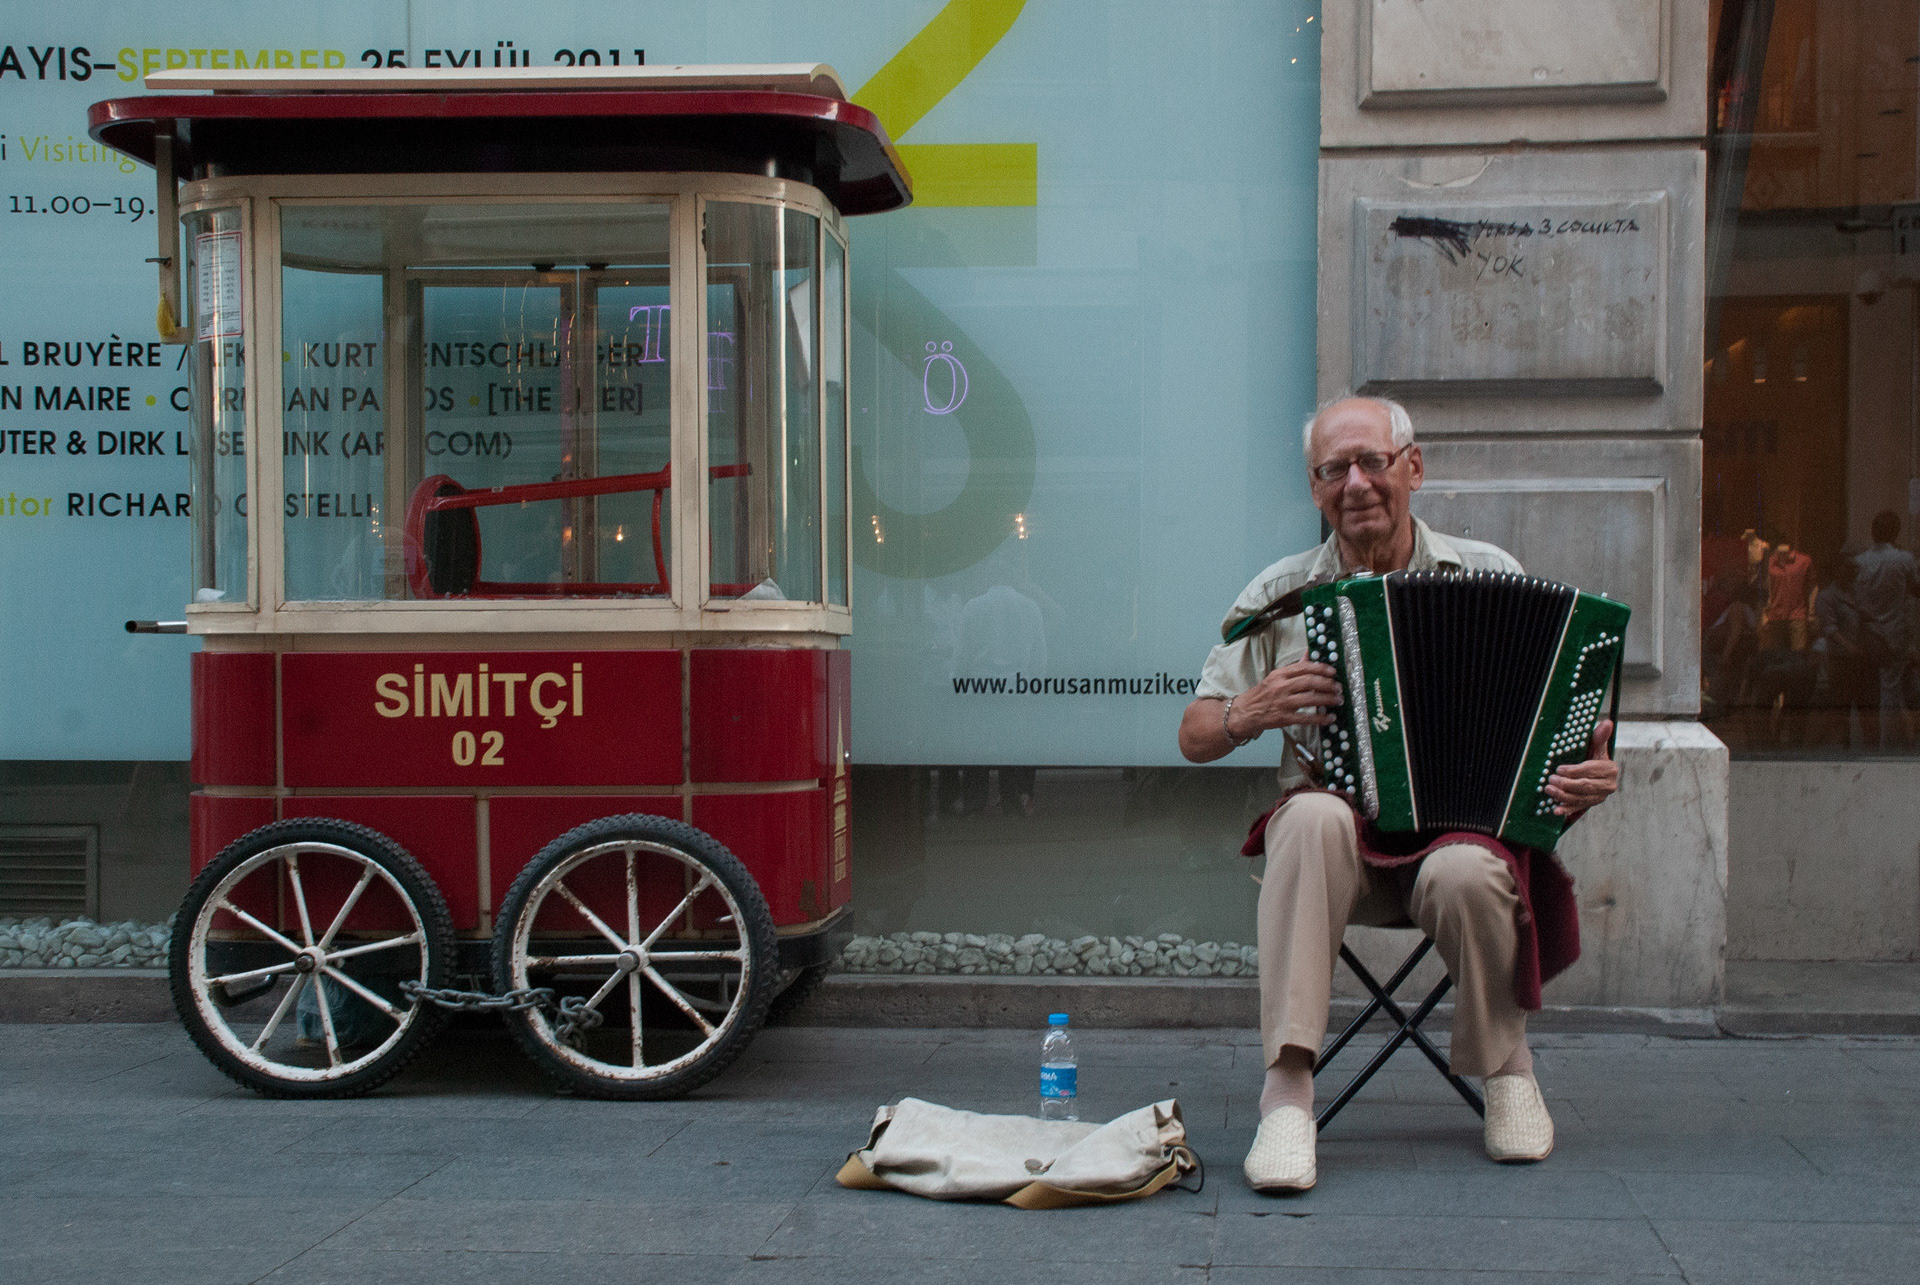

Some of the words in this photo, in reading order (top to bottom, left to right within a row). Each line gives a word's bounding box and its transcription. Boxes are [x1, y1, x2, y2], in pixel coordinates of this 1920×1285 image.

[1475, 251, 1524, 282] YOK
[23, 333, 162, 367] BRUYÈRE
[304, 342, 377, 368] KURT
[35, 386, 131, 411] MAIRE
[66, 430, 87, 456] &
[98, 431, 166, 456] DIRK
[0, 492, 53, 516] tor
[374, 662, 583, 729] SİMİTÇİ
[451, 730, 505, 766] 02
